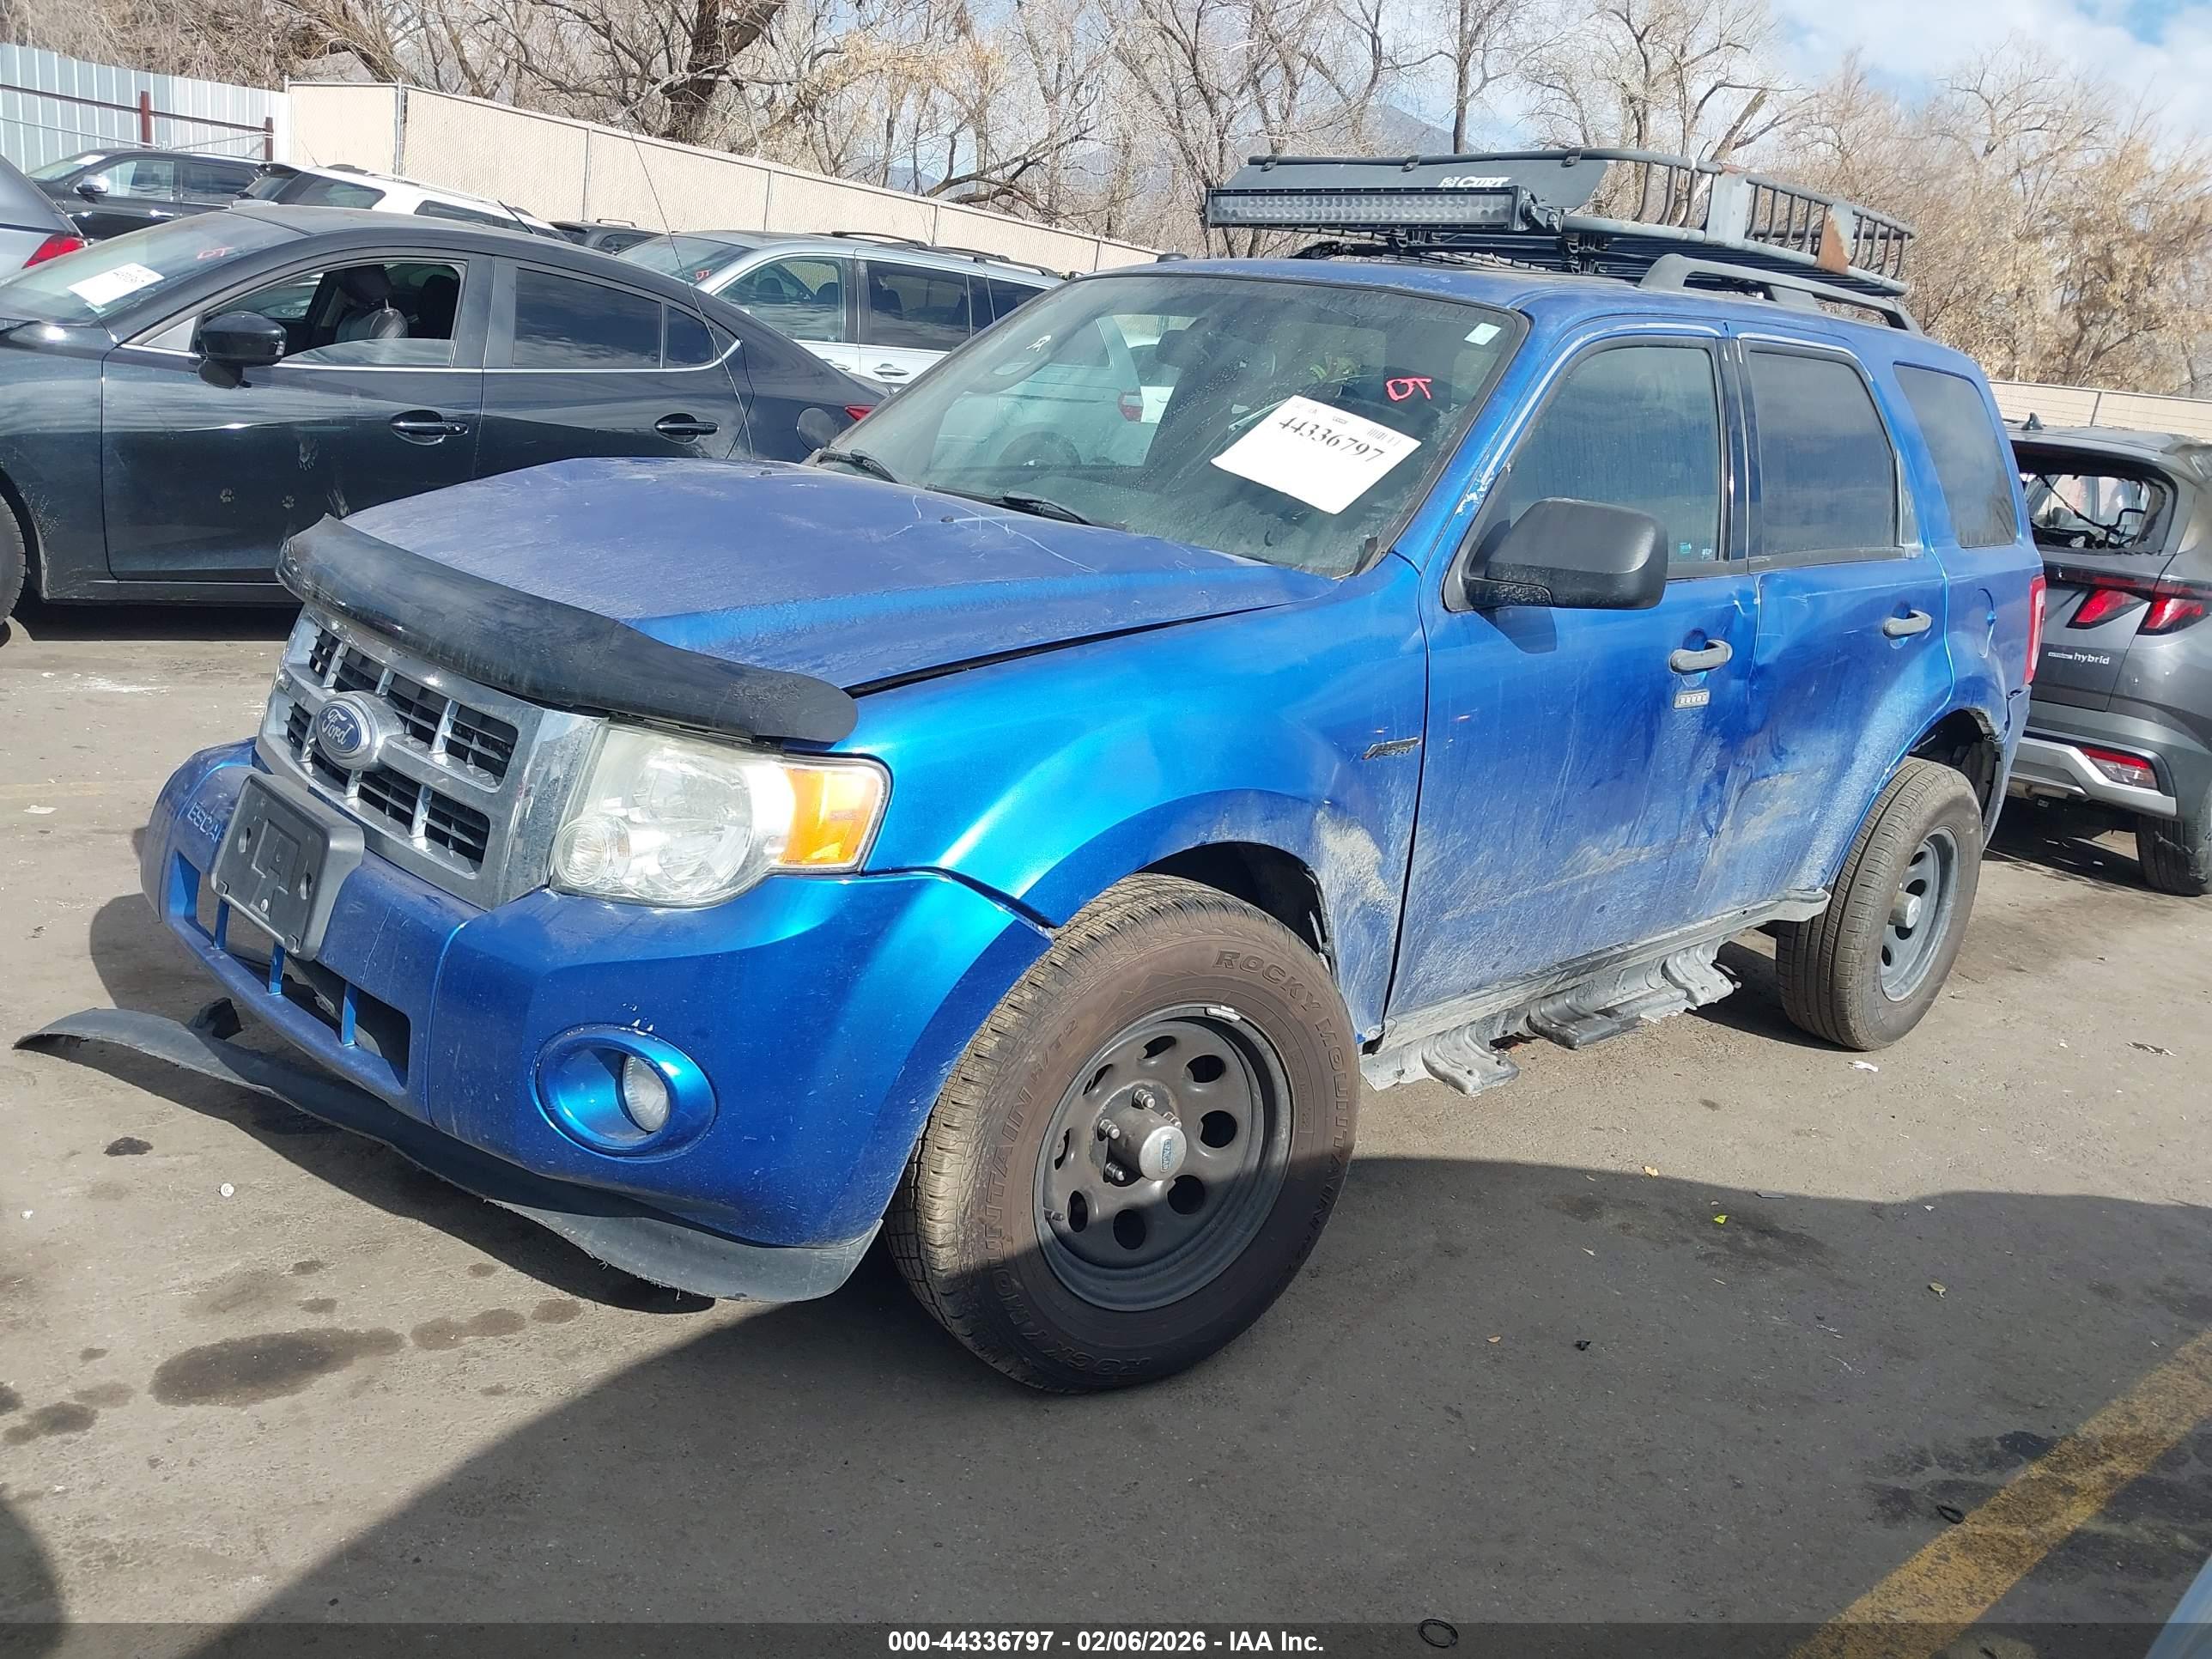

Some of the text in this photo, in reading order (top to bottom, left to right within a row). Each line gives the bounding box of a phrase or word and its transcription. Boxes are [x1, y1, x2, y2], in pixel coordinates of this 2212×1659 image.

[1278, 416, 1386, 463] 44336797
[2073, 652, 2110, 665] hybrid
[321, 708, 355, 745] Ford
[1212, 948, 1322, 1012] ROCKY
